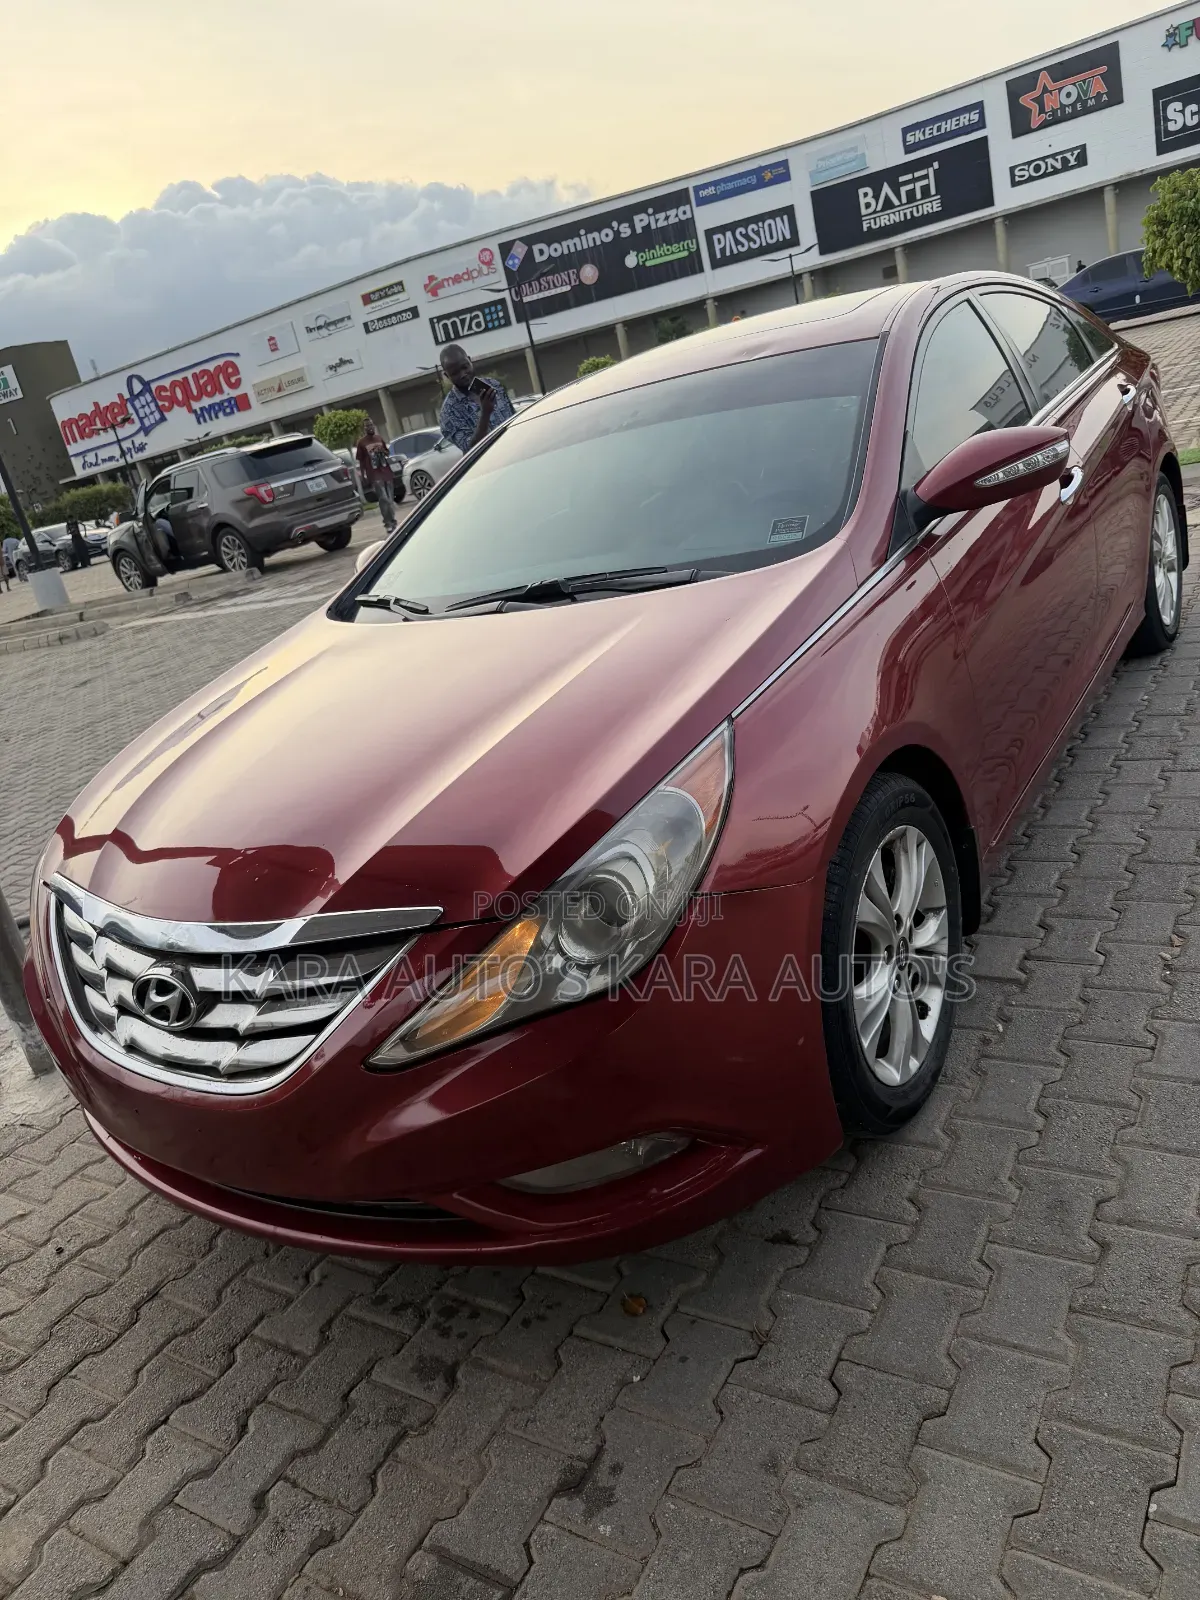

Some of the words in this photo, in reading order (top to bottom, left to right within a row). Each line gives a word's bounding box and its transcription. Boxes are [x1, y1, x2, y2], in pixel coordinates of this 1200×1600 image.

[1044, 76, 1108, 113] NOVA
[1046, 94, 1109, 120] CINEMA
[905, 109, 980, 146] SKECHERS
[1014, 149, 1081, 182] SONY
[716, 174, 757, 195] pharmacy
[862, 199, 942, 232] FURNITURE
[532, 219, 632, 263] Domino's
[633, 203, 693, 235] Pizza
[637, 238, 697, 266] pinkberry
[440, 263, 497, 289] medplus
[541, 268, 580, 291] STONE
[433, 310, 486, 343] imza
[60, 392, 135, 446] market
[153, 359, 242, 413] square
[192, 396, 239, 425] HYPER
